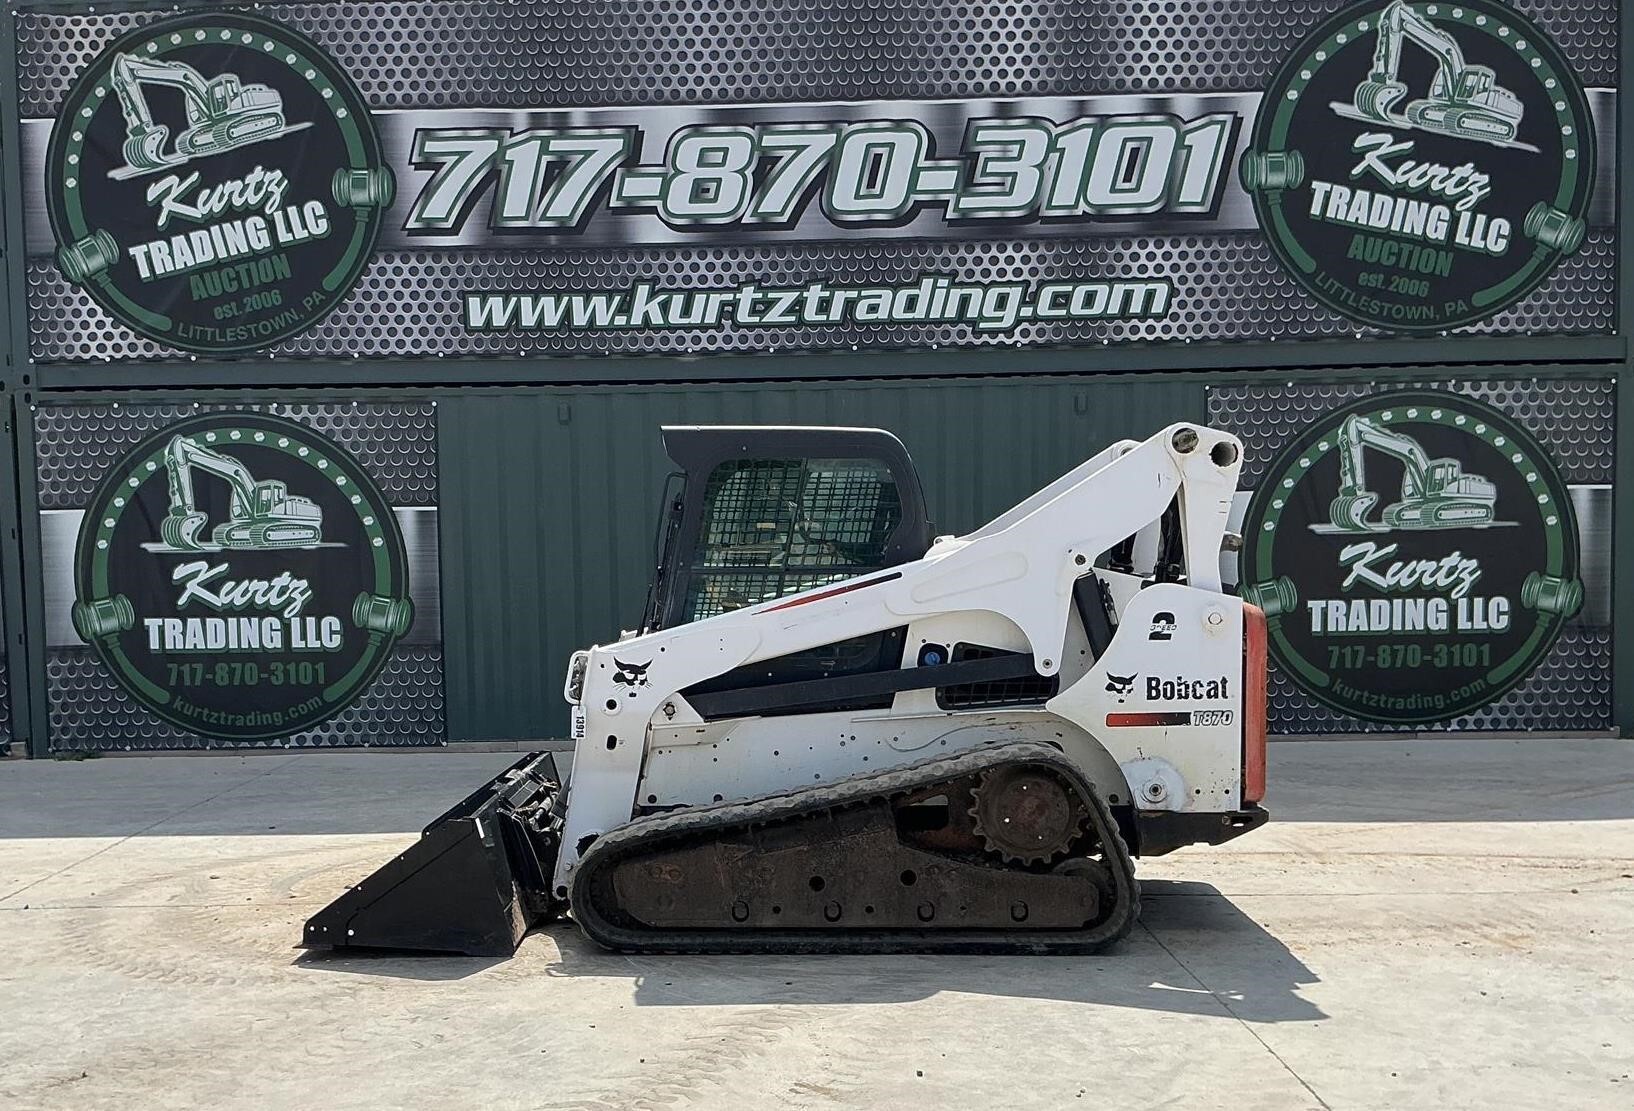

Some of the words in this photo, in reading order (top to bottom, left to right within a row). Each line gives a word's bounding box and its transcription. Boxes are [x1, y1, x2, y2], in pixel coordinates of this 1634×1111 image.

[406, 116, 1234, 231] 717-870-3101
[1352, 132, 1491, 211] Kurtz
[147, 166, 289, 227] Kurtz
[1309, 181, 1451, 242] TRADING
[1453, 210, 1511, 253] LLC
[129, 215, 271, 280] TRADING
[273, 200, 330, 242] LLC
[1347, 234, 1455, 278] AUCTION
[190, 254, 292, 300] AUCTION
[1315, 271, 1440, 320] LITTLESTOWN,
[1444, 300, 1468, 320] PA
[1358, 272, 1388, 290] est.
[1391, 275, 1430, 297] 2006
[177, 308, 305, 342] LITTLESTOWN,
[303, 290, 326, 313] PA
[213, 298, 241, 321] est.
[244, 289, 282, 315] 2006
[465, 278, 1173, 331] www.kurtztrading.com
[172, 561, 312, 618] Kurtz
[1340, 542, 1482, 599] Kurtz
[145, 617, 282, 650] TRADING
[290, 616, 341, 649] LLC
[1308, 598, 1450, 632] TRADING
[1457, 596, 1509, 631] LLC
[167, 661, 326, 687] 717-870-3101
[1328, 643, 1490, 669] 717-870-3101
[1146, 675, 1229, 701] Bobcat
[1331, 678, 1487, 712] kurtztrading.com
[172, 694, 323, 728] kurtztrading.com
[576, 715, 585, 738] 13914
[1192, 710, 1233, 726] T870
